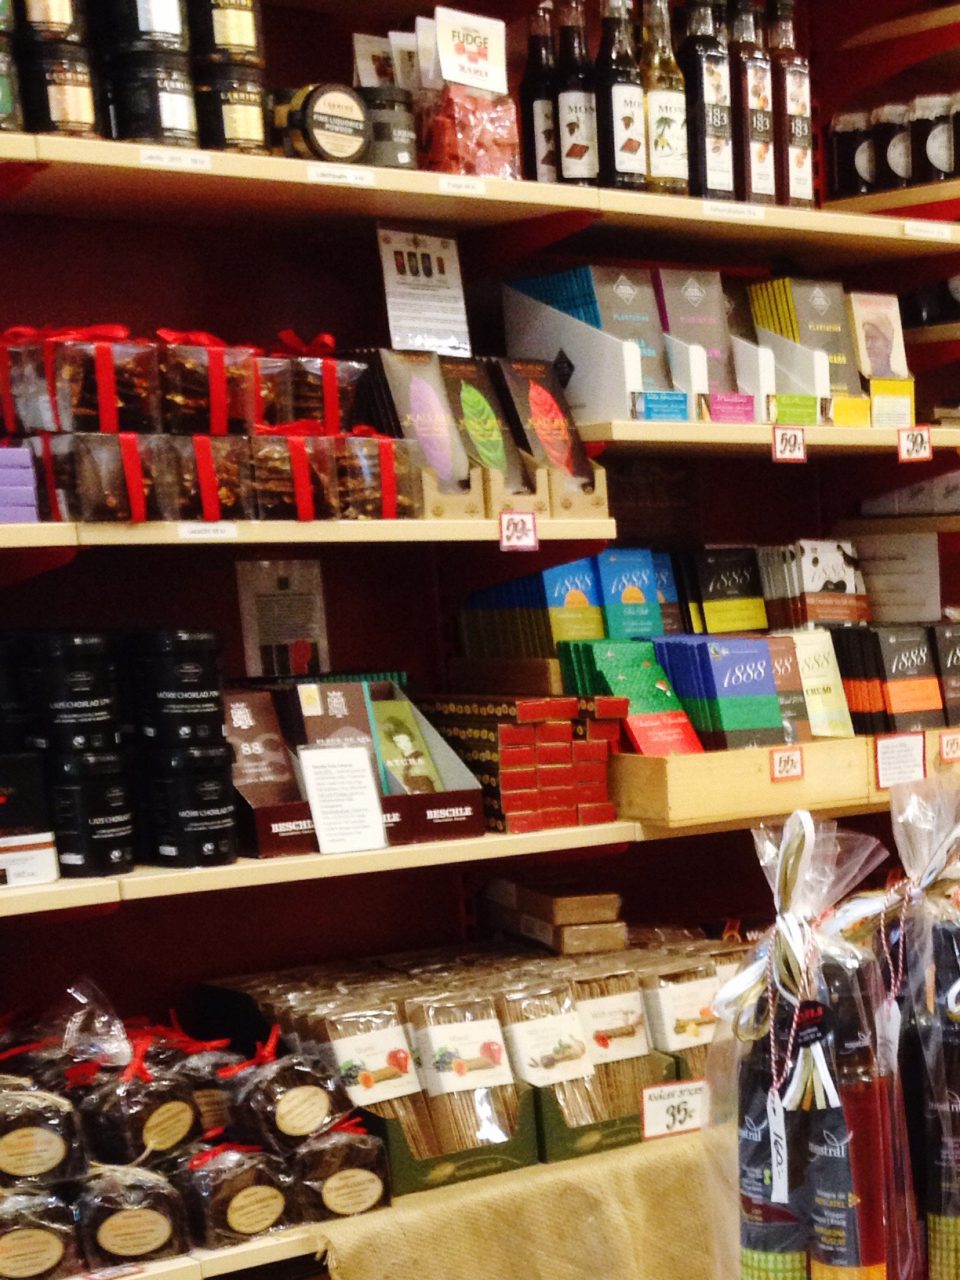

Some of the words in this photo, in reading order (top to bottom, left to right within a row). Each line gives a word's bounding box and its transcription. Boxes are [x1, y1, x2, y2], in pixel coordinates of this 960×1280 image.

[451, 30, 489, 50] FUDGE
[708, 567, 752, 593] 1888
[772, 656, 793, 676] 88
[891, 647, 928, 674] 1888
[723, 660, 767, 688] 1888
[240, 742, 263, 756] 88
[426, 807, 473, 820] BESCHLE
